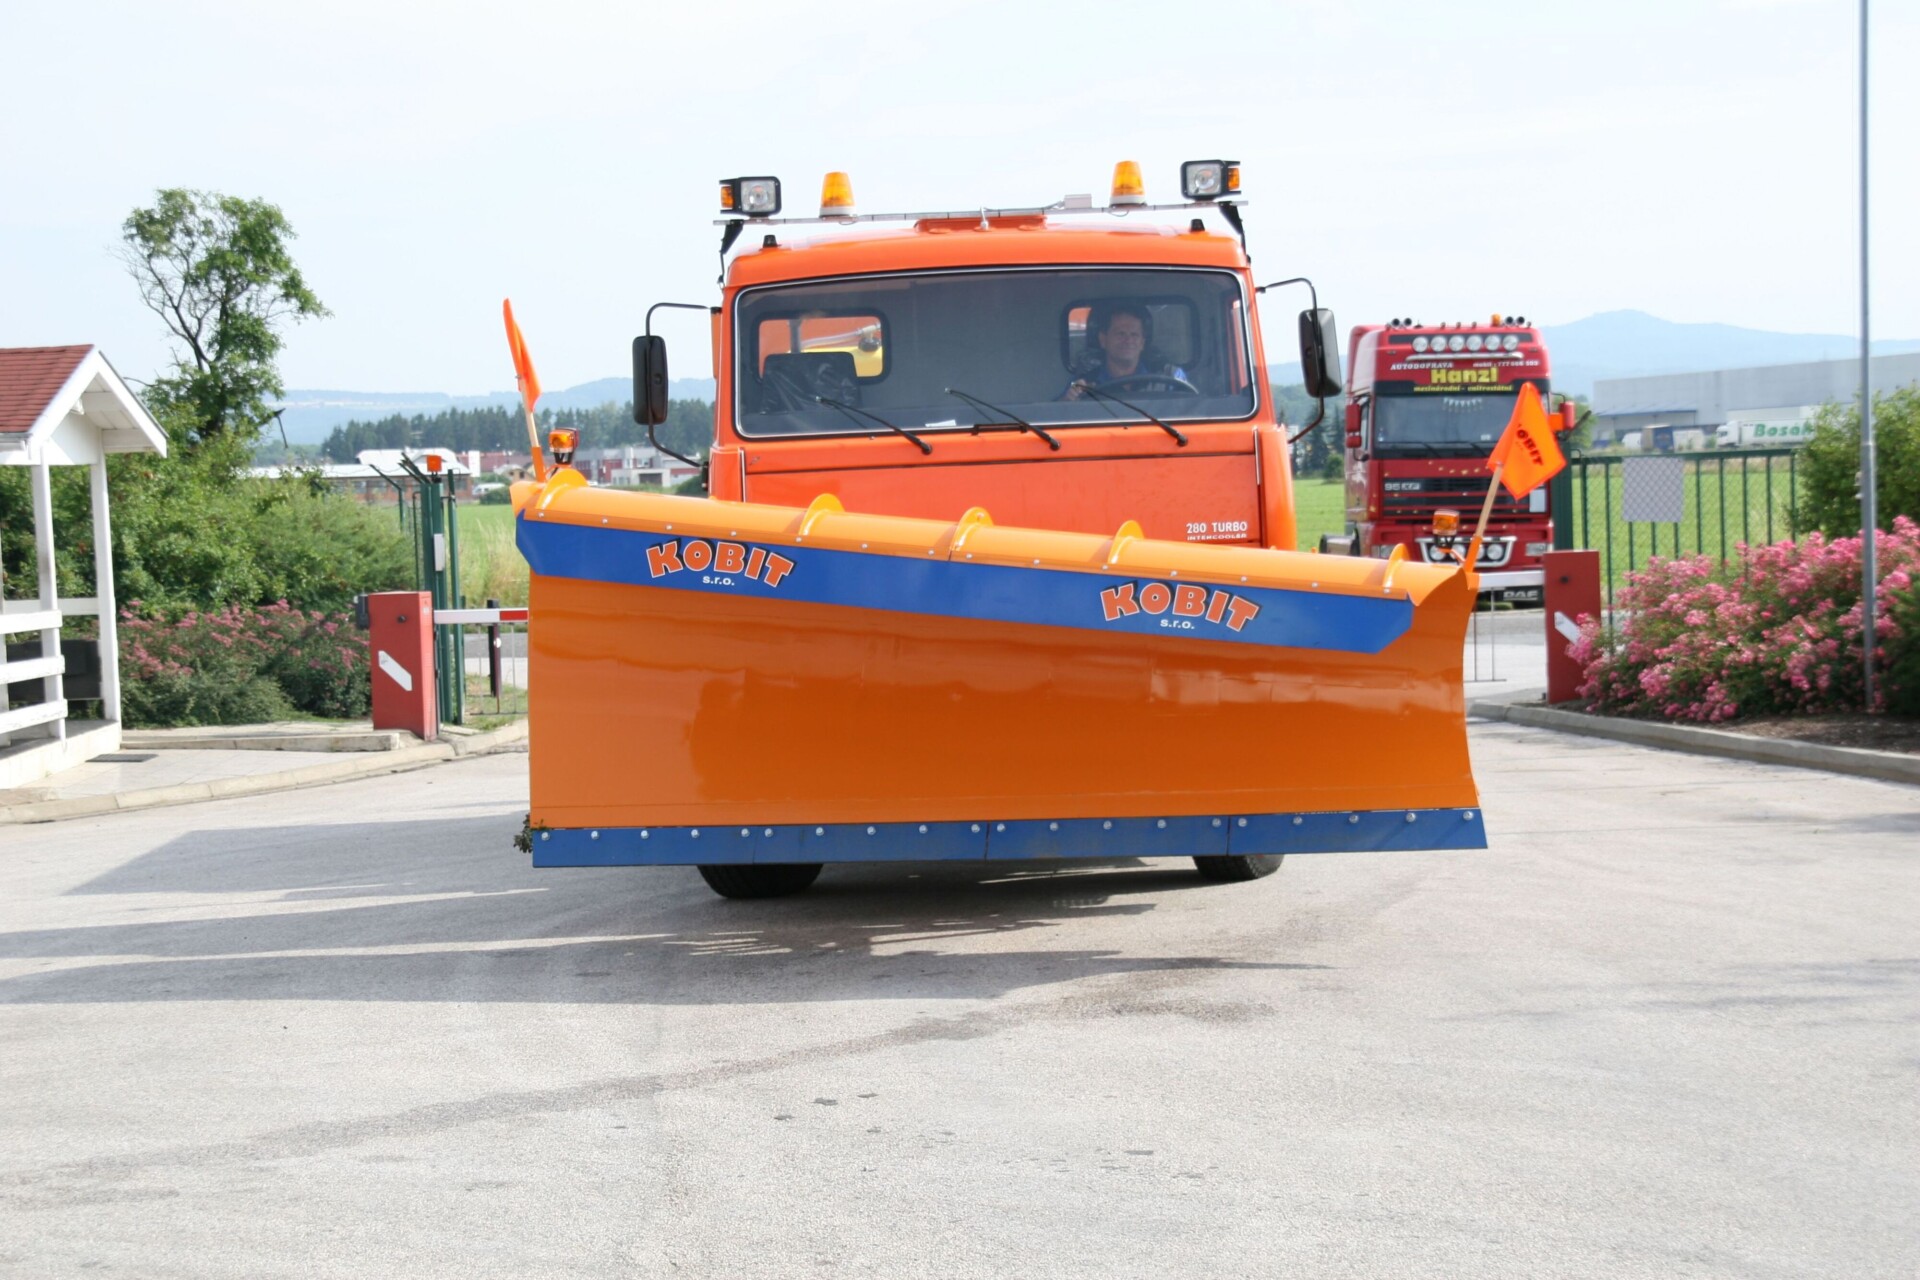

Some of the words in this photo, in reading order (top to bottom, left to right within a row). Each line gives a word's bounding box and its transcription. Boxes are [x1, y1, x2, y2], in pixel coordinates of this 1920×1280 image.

[1430, 367, 1498, 384] Hanzl
[1516, 423, 1544, 467] OBIT
[1186, 522, 1207, 534] 280
[1211, 521, 1248, 532] TURBO
[646, 539, 795, 588] KOBIT
[702, 575, 735, 586] s.r.o.
[1503, 590, 1539, 599] DAF
[1100, 582, 1260, 632] KOBIT
[1160, 619, 1195, 629] s.r.o.
